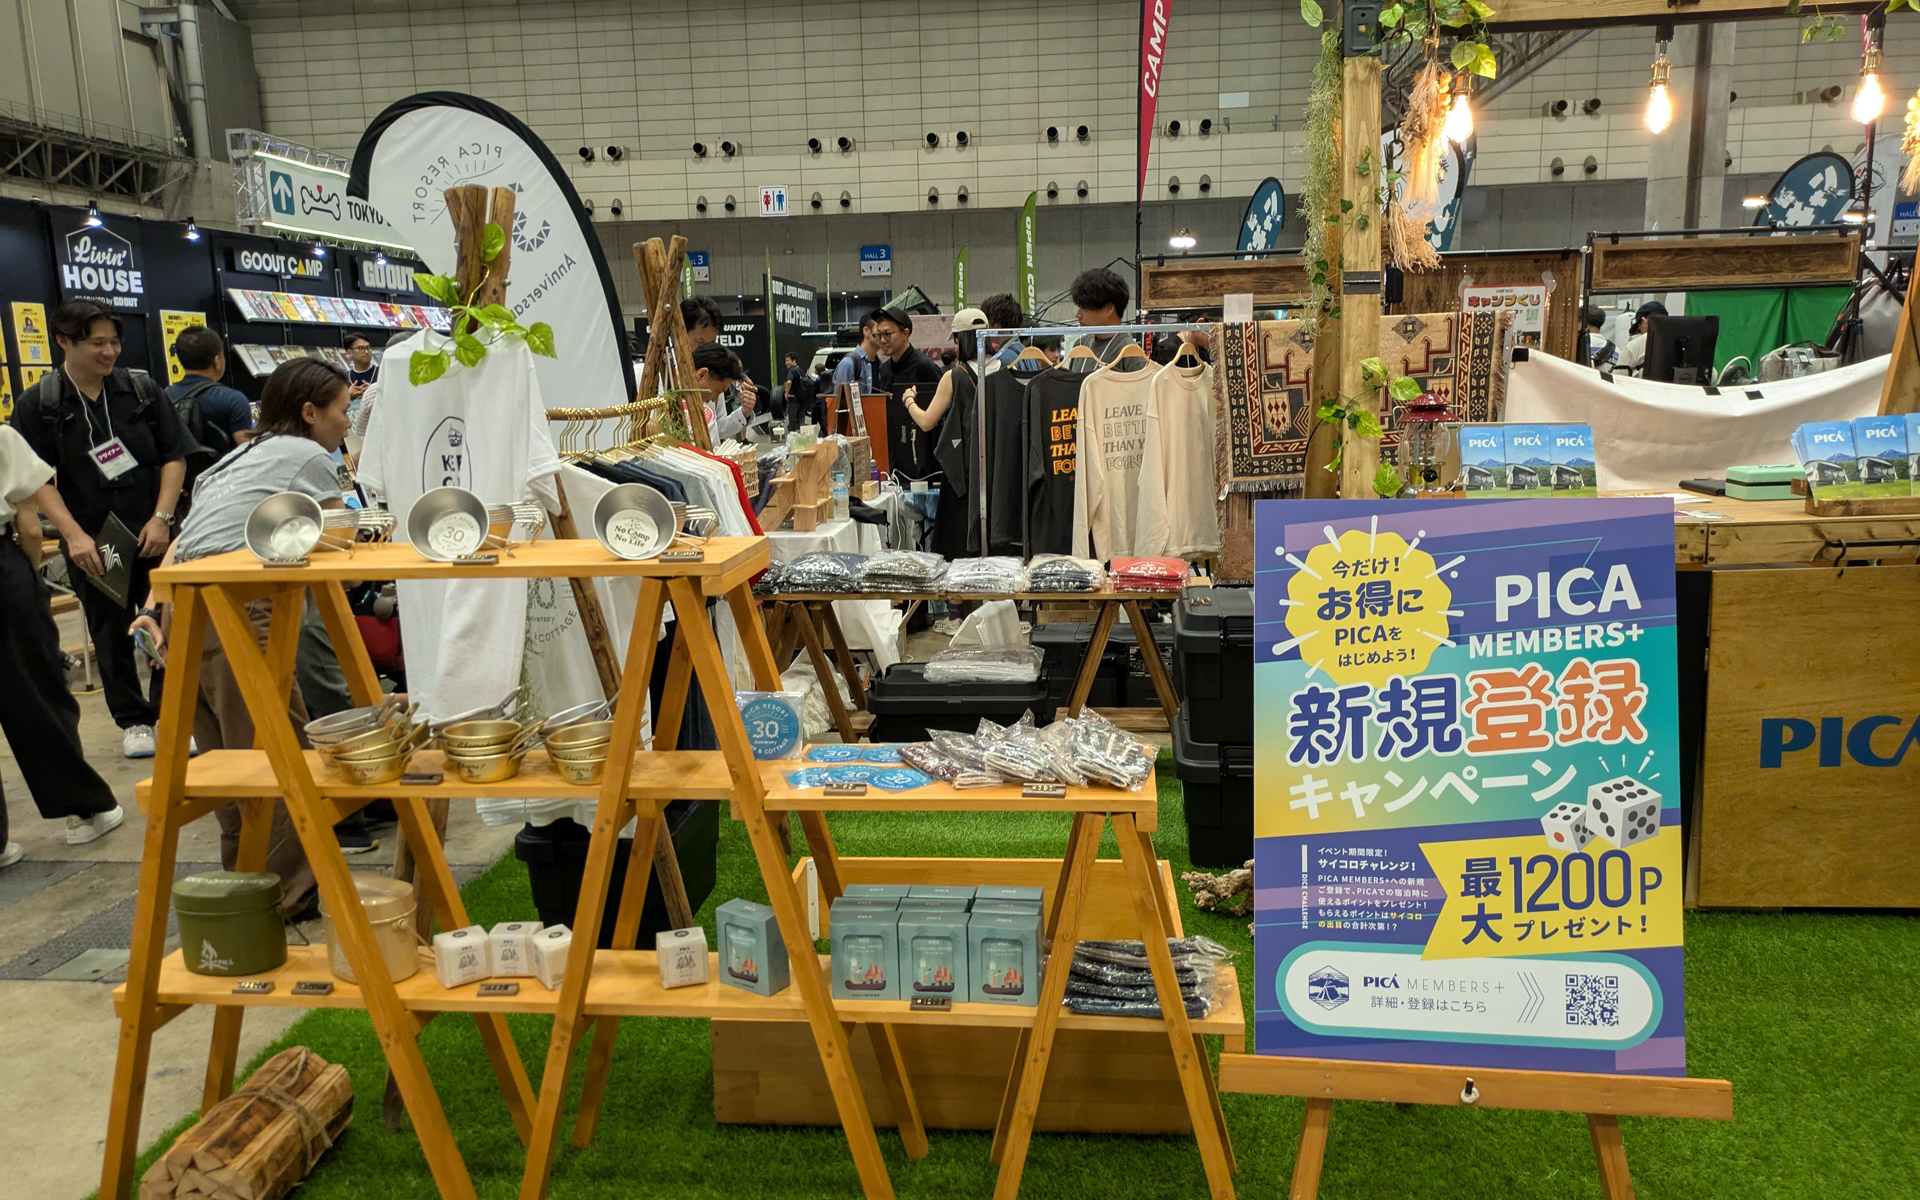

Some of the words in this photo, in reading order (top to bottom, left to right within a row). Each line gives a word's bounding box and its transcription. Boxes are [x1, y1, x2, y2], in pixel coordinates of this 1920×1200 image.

[1144, 0, 1166, 98] CAMP
[1026, 216, 1034, 268] OPEN
[74, 236, 127, 266] Livin'
[698, 254, 704, 265] 3
[880, 248, 886, 258] 3
[62, 264, 144, 294] HOUSE
[787, 284, 798, 298] OPEN
[798, 288, 814, 302] COUNTRY
[1468, 294, 1540, 308] キャンプくじ
[1052, 407, 1078, 423] LEA
[1104, 404, 1142, 420] LEAVE
[1050, 442, 1076, 458] THA
[1103, 439, 1135, 454] THAN
[1106, 454, 1143, 472] FOUN
[444, 526, 465, 542] 30
[614, 525, 626, 533] No
[614, 534, 627, 543] No
[628, 538, 646, 548] Life
[1332, 556, 1400, 579] 今だけ！
[1316, 580, 1424, 621] お得に
[1496, 564, 1642, 622] PICA
[539, 610, 577, 642] COTTAGE
[1335, 624, 1402, 646] PICAを
[1469, 622, 1644, 659] MEMBERS+
[1338, 648, 1416, 667] はじめよう！
[762, 703, 788, 718] RESORT
[1286, 656, 1648, 767] 新規登録
[752, 720, 779, 738] 30
[764, 738, 789, 754] COTTAGE
[844, 770, 870, 778] 30
[1288, 758, 1578, 820] キャンペーン
[1318, 847, 1388, 857] イベント期間限定！
[1318, 858, 1416, 872] サイコロチャレンジ！
[1318, 886, 1428, 898] ご登録で、PICAでの宿泊時に
[1318, 897, 1427, 909] 使えるポイントをプレゼント！
[1461, 857, 1503, 945] 最大
[1318, 909, 1423, 920] もらえるポイントはサイコロ
[1514, 914, 1647, 942] プレゼント！
[1407, 978, 1505, 994] MEMBERS+
[1371, 995, 1487, 1013] 詳細・登録はこちら
